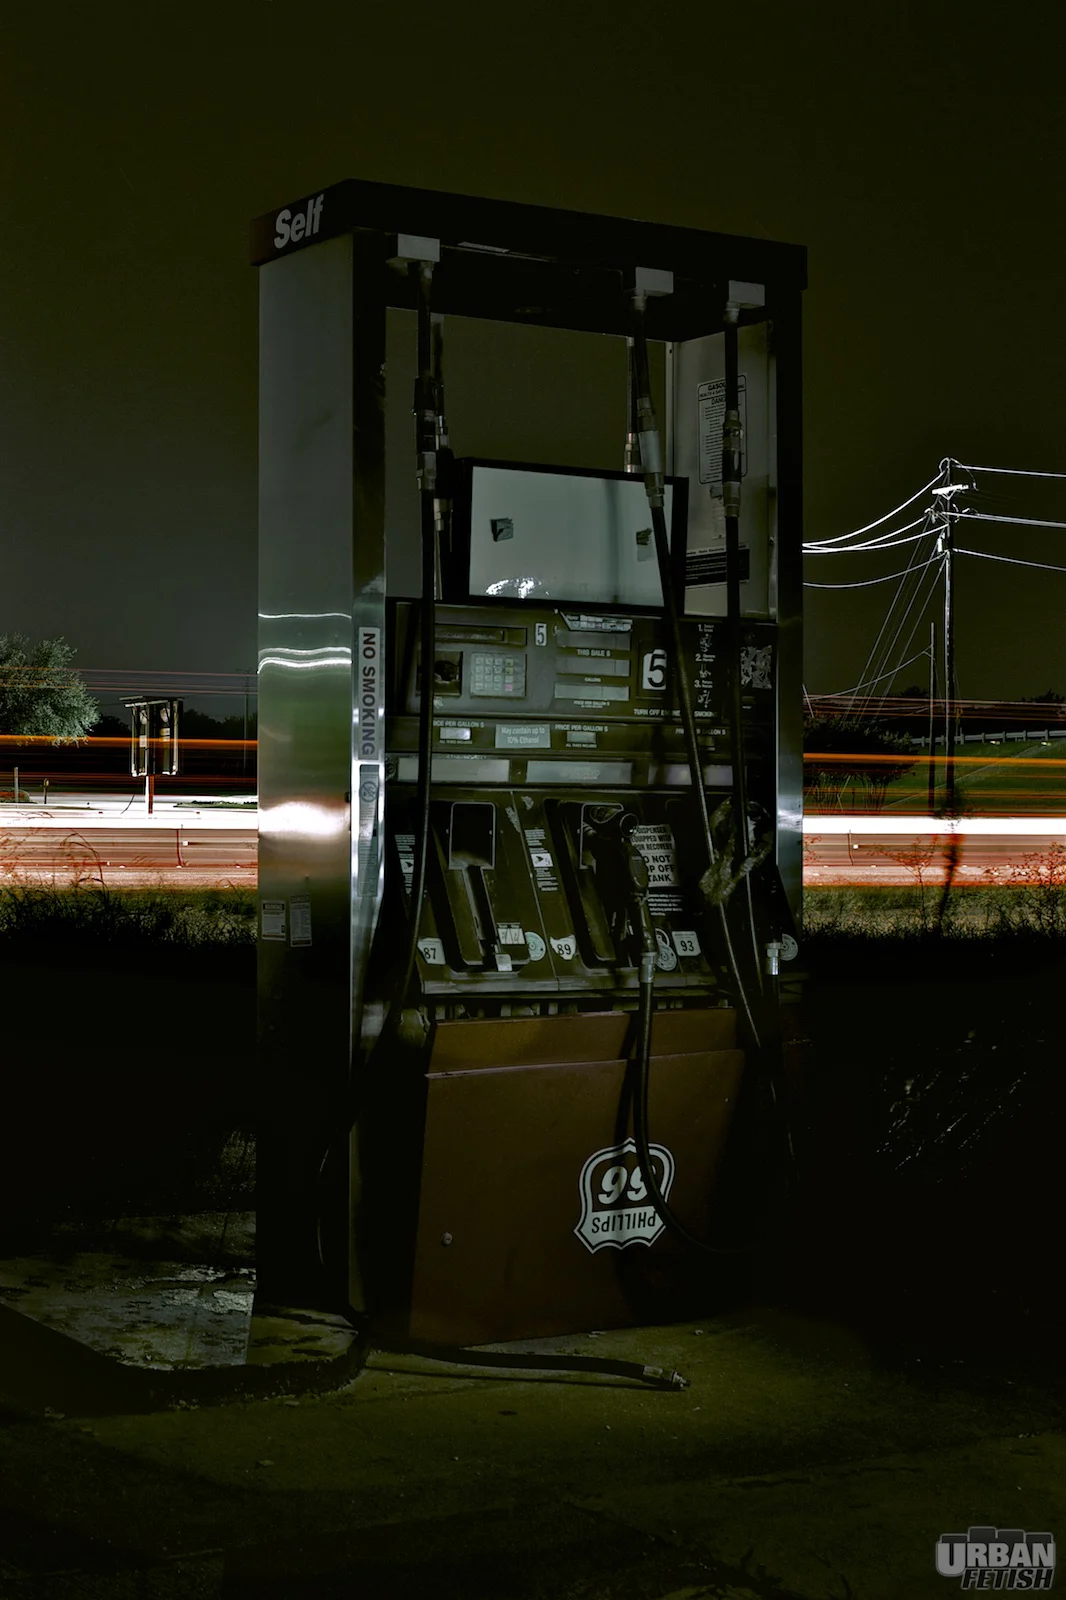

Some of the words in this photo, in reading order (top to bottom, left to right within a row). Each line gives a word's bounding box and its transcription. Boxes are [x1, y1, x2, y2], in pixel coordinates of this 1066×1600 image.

[273, 193, 325, 249] Self
[536, 624, 545, 645] 5
[362, 633, 376, 660] NO
[576, 648, 590, 657] THIS
[590, 649, 606, 657] SALE
[648, 652, 665, 688] 5
[361, 666, 376, 756] SMOKING
[633, 708, 649, 716] TURN
[648, 708, 661, 717] OFF
[445, 719, 457, 728] PER
[457, 719, 480, 729] GALLON
[554, 723, 570, 731] PRICE
[512, 727, 532, 735] contain
[519, 736, 540, 744] Ethanol
[651, 855, 671, 863] NOT
[657, 864, 676, 873] OFF
[557, 943, 571, 956] 89
[680, 940, 694, 952] 93
[423, 947, 437, 960] 87
[591, 1211, 657, 1234] PHILLIPS
